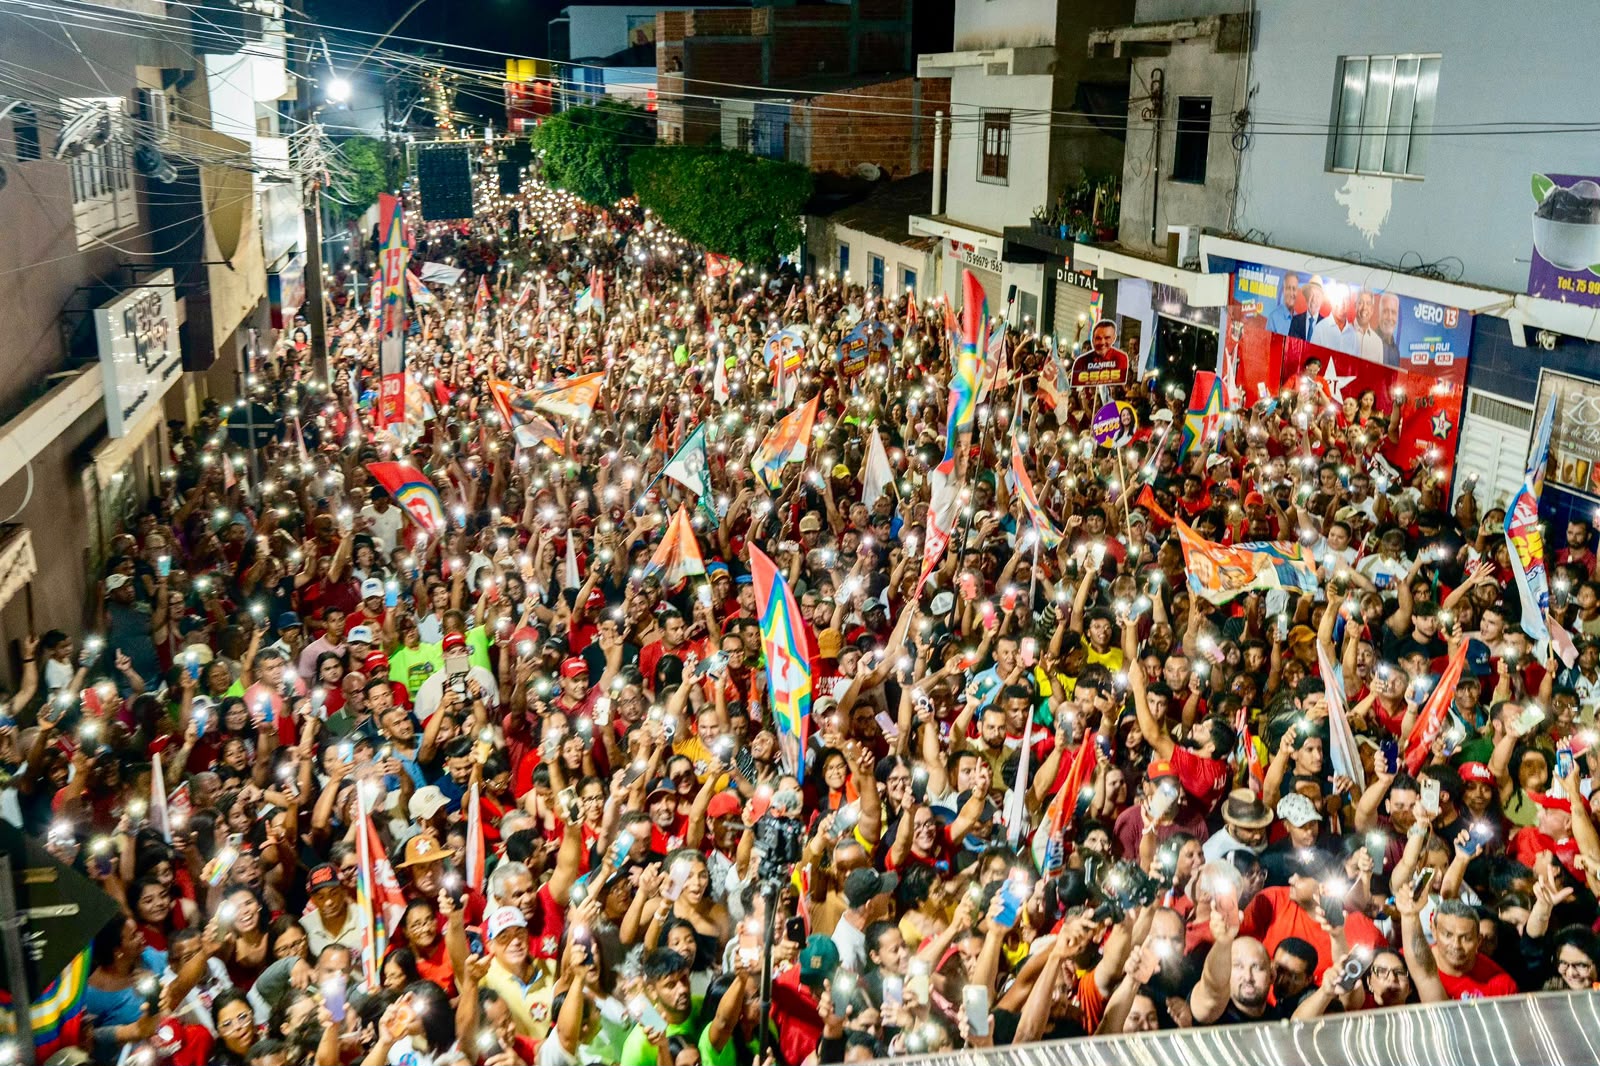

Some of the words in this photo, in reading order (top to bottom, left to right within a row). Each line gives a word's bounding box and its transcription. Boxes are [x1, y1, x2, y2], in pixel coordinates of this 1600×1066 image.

[1057, 268, 1098, 291] DIGITAL
[1576, 278, 1587, 293] 75
[1446, 309, 1457, 327] 13
[1435, 342, 1450, 352] RUI
[1078, 369, 1121, 382] 6565
